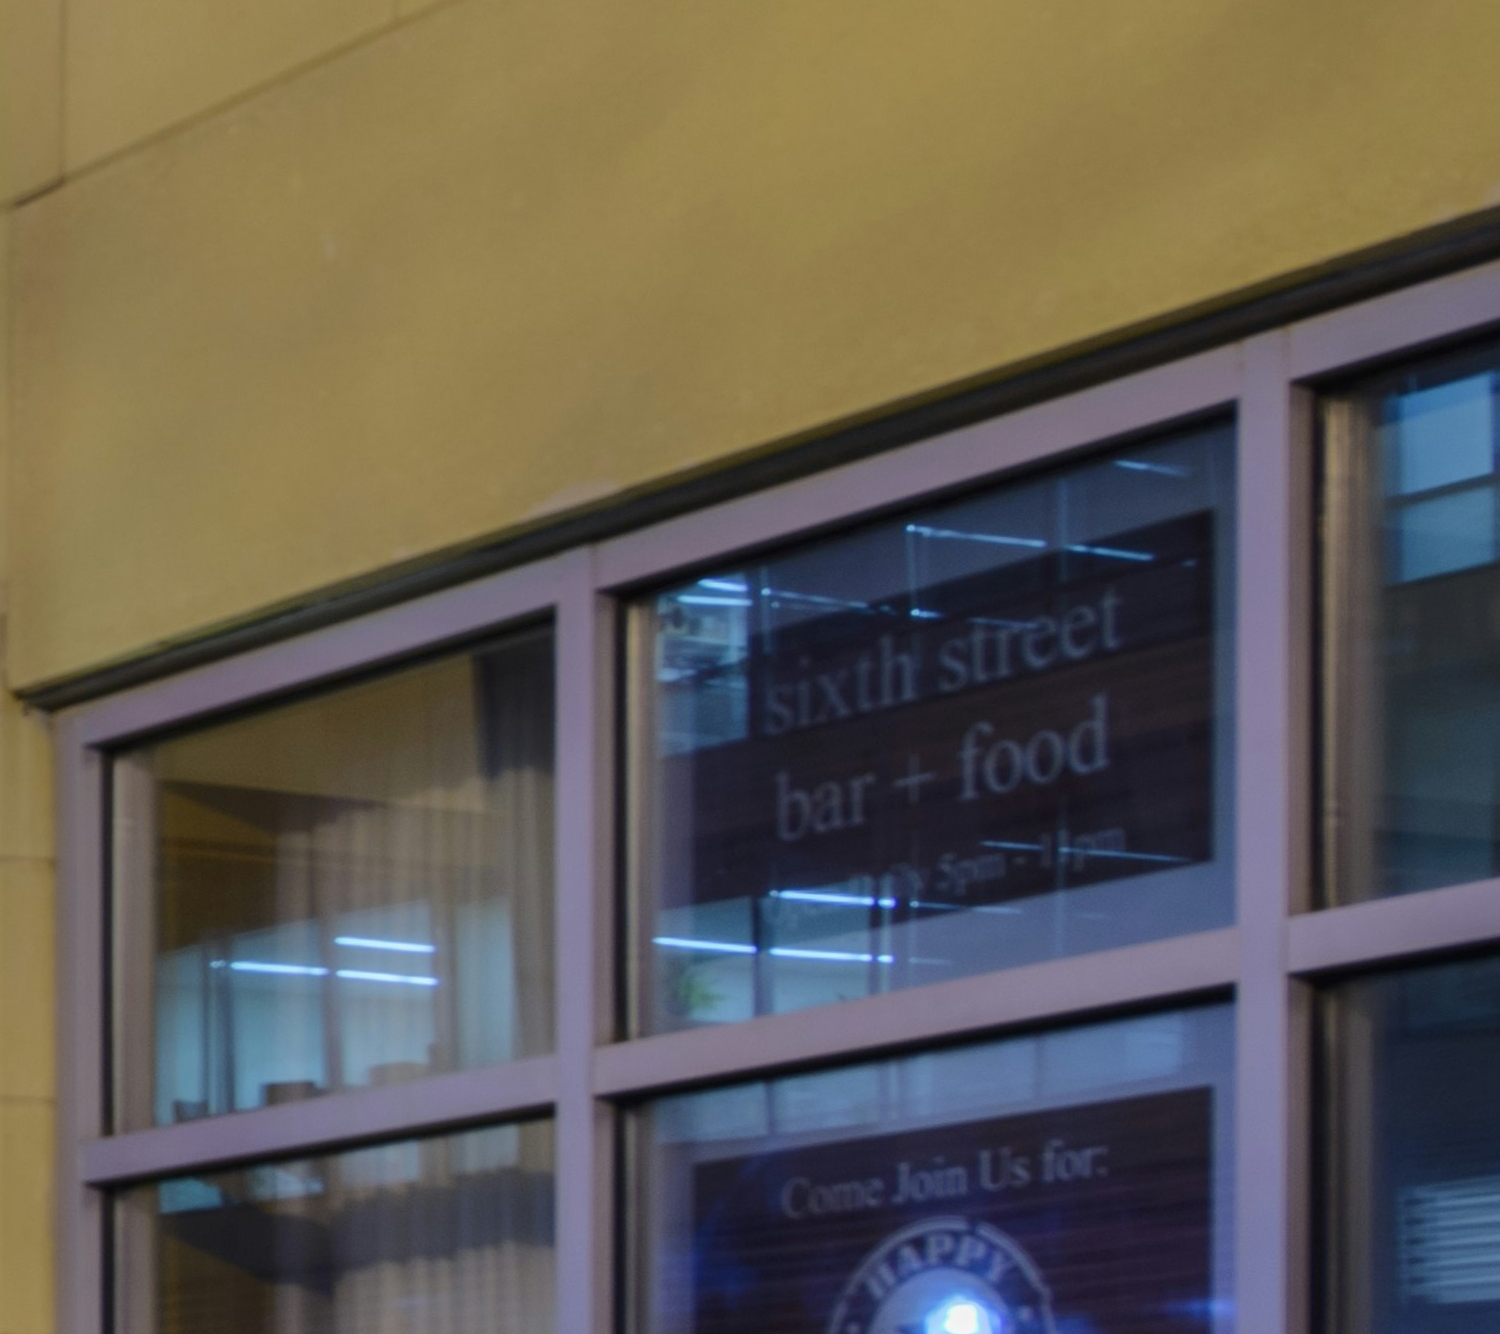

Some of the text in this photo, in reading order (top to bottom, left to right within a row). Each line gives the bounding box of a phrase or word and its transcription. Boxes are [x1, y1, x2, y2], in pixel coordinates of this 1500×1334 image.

[761, 586, 1126, 738] sixth street
[774, 692, 1113, 843] bar + food
[780, 1137, 1111, 1220] Come Join Us for:
[861, 1230, 1015, 1301] HAPPY
